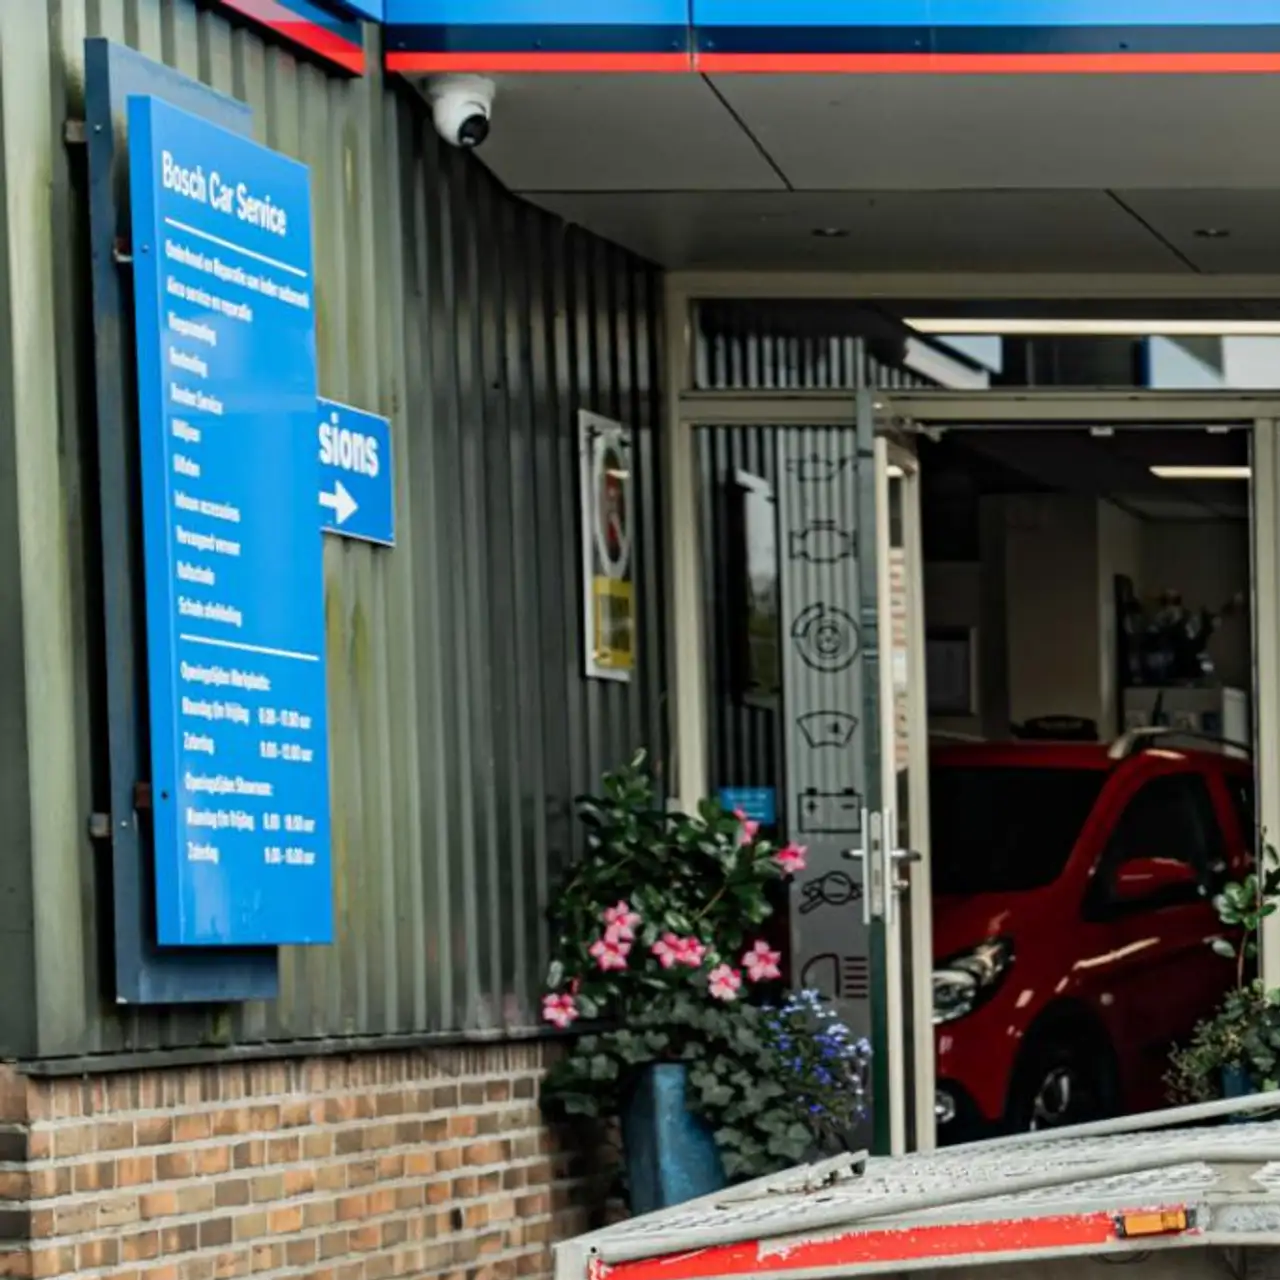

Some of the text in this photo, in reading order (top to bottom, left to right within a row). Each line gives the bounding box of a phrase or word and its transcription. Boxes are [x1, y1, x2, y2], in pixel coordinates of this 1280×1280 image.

[162, 150, 287, 237] Bosch Car Service
[319, 412, 379, 477] sions
